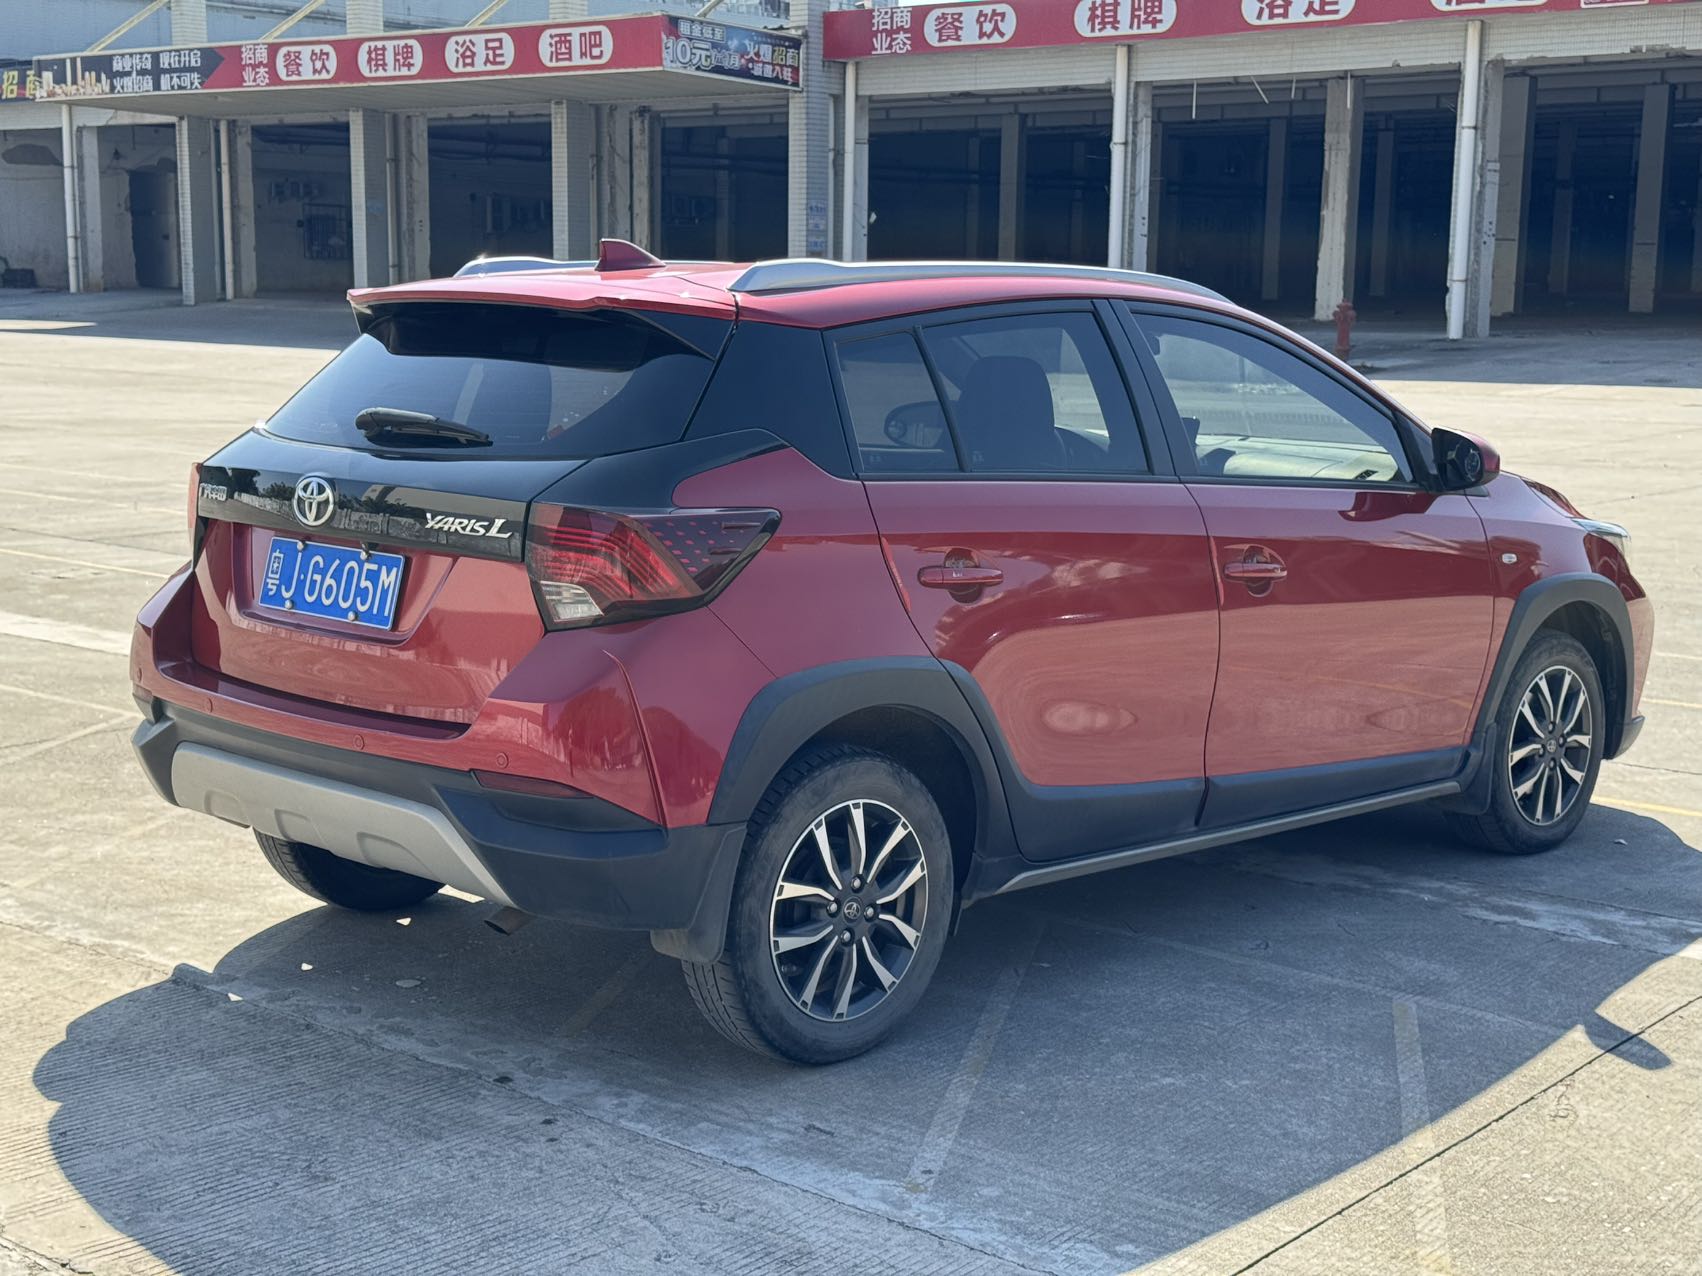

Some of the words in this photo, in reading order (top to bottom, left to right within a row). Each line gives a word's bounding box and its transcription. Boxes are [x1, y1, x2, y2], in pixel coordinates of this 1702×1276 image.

[871, 7, 911, 31] 招商
[934, 8, 1007, 43] 餐饮
[1087, 0, 1165, 33] 棋牌
[241, 44, 269, 65] 招商
[454, 37, 506, 68] 浴足
[549, 30, 604, 63] 酒吧
[871, 32, 912, 54] 业态
[112, 53, 152, 72] 商业传奇
[160, 50, 201, 69] 现在开启
[282, 49, 331, 78] 餐饮
[366, 42, 416, 73] 棋牌
[113, 75, 153, 93] 火爆招商
[160, 72, 201, 90] 机不可失
[242, 66, 270, 87] 业态
[424, 512, 489, 537] YARIS
[485, 517, 514, 539] L
